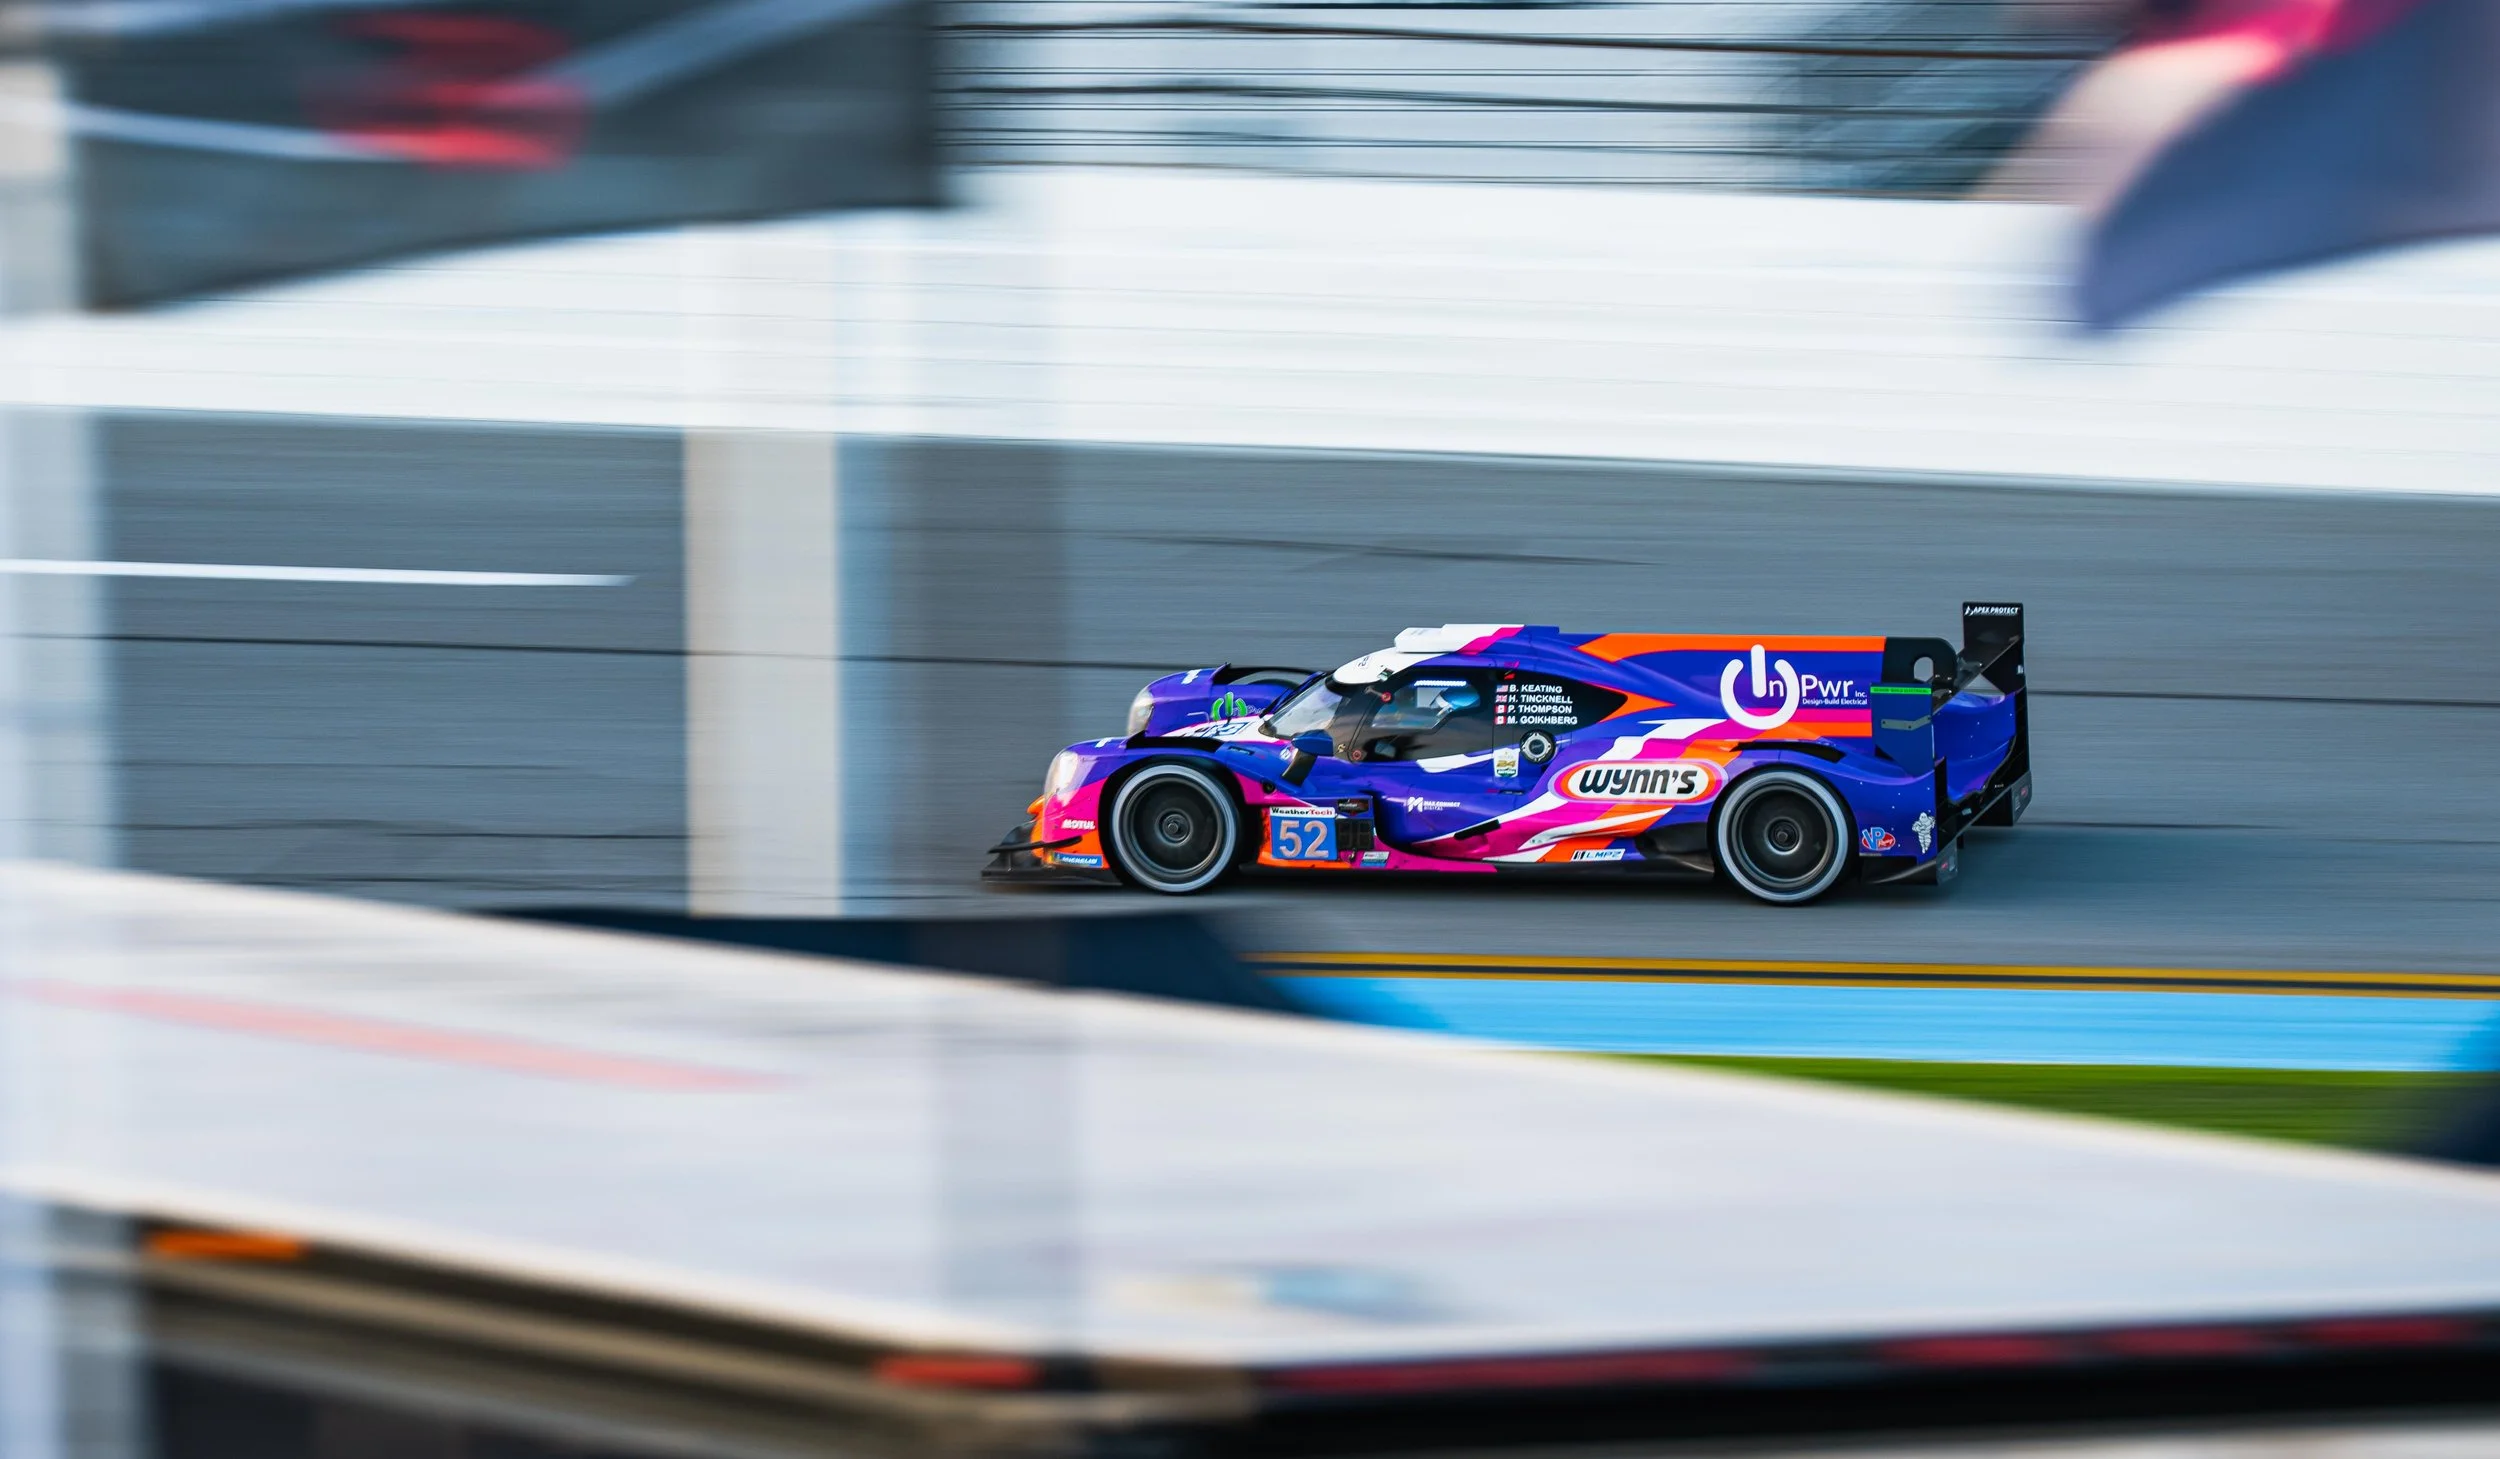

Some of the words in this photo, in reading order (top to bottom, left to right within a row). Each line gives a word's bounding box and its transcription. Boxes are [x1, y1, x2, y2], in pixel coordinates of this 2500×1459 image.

[1973, 606, 1990, 615] APEX
[1990, 606, 2019, 616] PROTECT
[1509, 684, 1519, 693] B.
[1521, 684, 1563, 694] KEATING
[1508, 694, 1518, 703] H.
[1521, 694, 1573, 704] TINCKNELL
[1802, 698, 1840, 706] Design-Build
[1841, 698, 1867, 706] Electrical
[1507, 705, 1516, 714] P.
[1518, 705, 1572, 714] THOMPSON
[1507, 716, 1518, 724] M.
[1520, 716, 1578, 725] GOIKHBERG
[1271, 807, 1333, 816] WeatherTech
[1061, 819, 1096, 830] MOTUL
[1279, 820, 1329, 858] 52
[1862, 827, 1886, 851] VP
